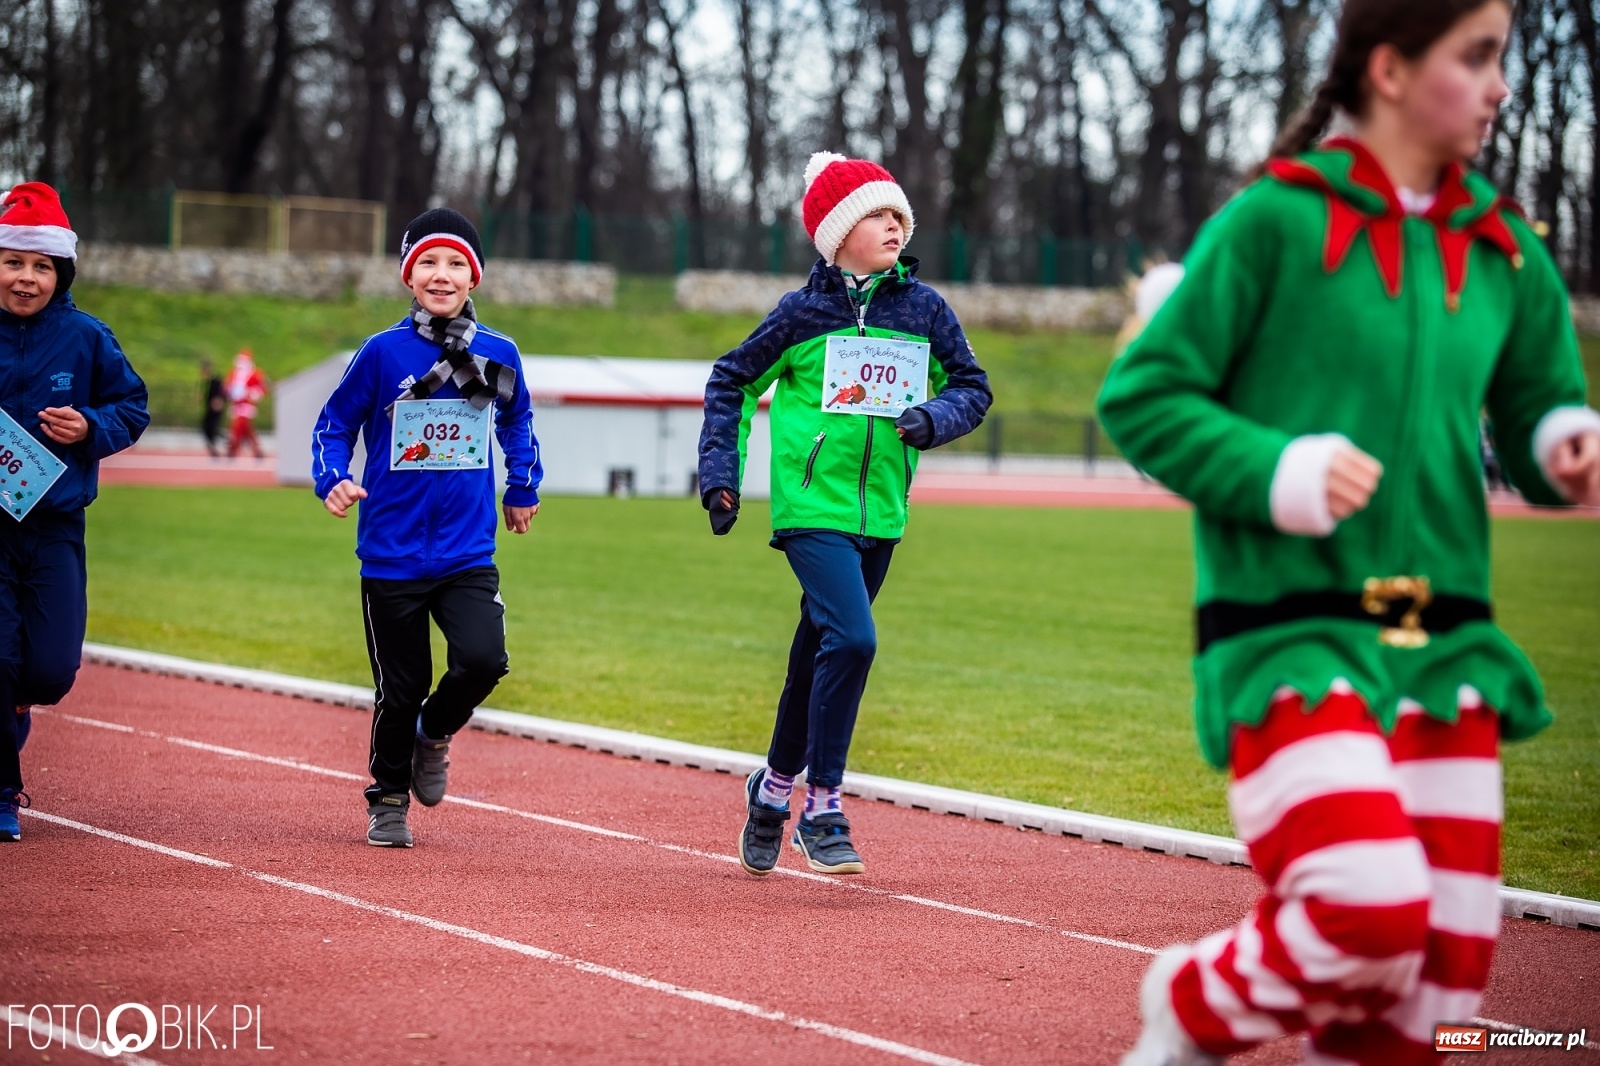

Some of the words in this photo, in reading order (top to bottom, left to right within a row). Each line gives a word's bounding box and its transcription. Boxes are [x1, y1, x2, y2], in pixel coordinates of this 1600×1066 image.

[860, 363, 897, 385] 070
[423, 423, 460, 441] 032
[0, 444, 23, 475] 86
